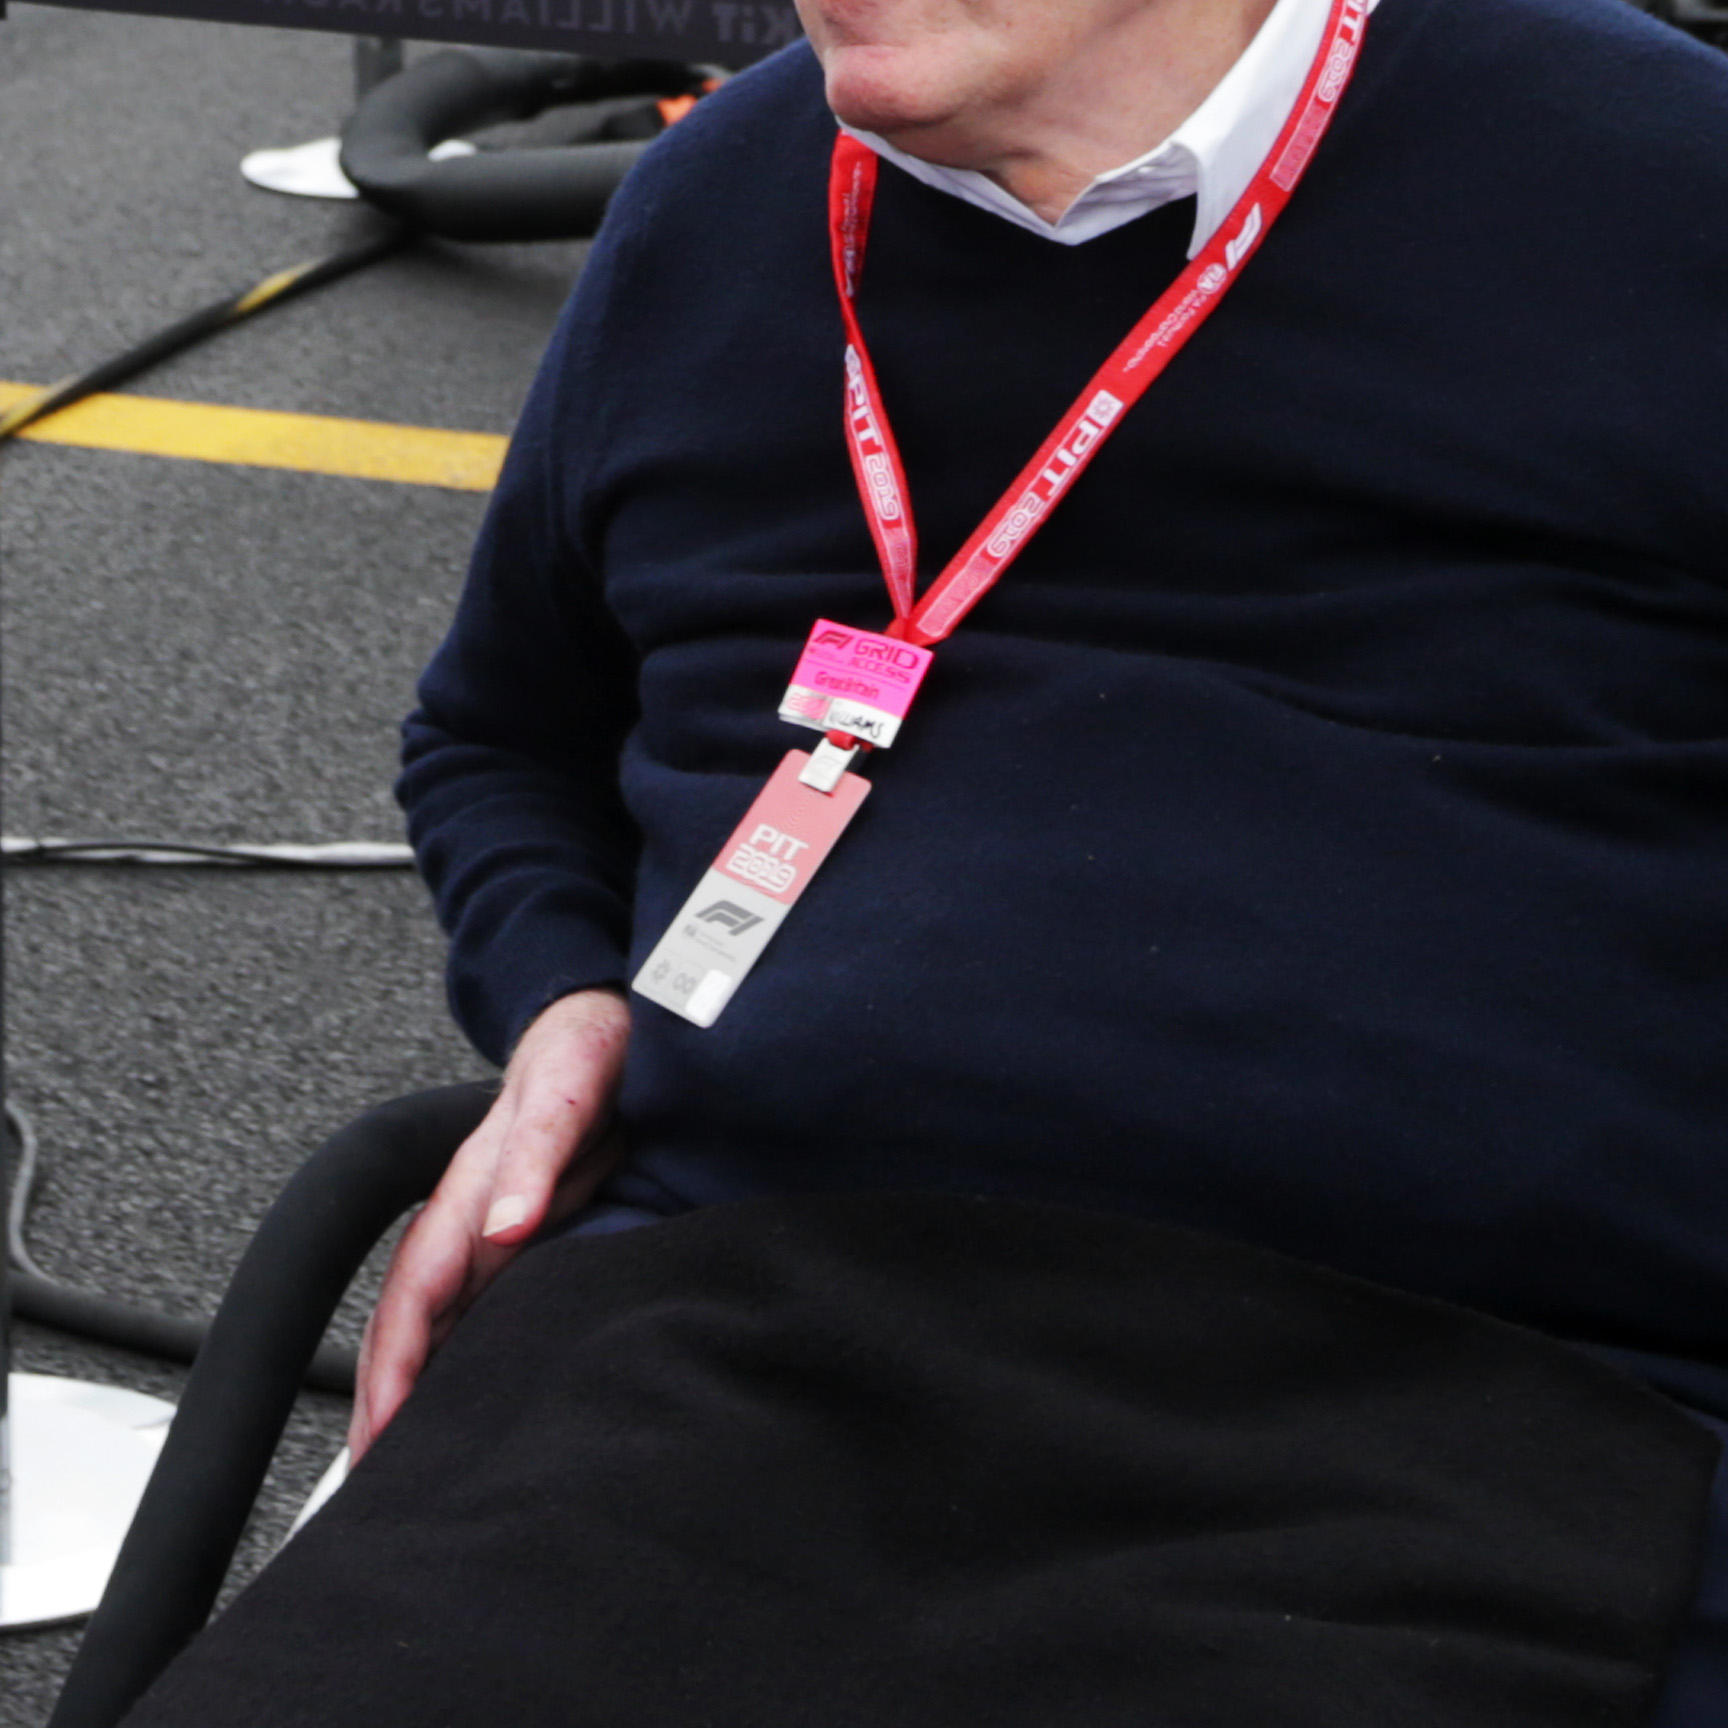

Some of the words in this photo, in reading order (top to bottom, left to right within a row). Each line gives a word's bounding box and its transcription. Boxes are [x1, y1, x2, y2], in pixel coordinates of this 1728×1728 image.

[1042, 419, 1101, 497] PIT
[849, 656, 914, 684] ACCESS
[854, 638, 920, 671] GRID
[748, 823, 811, 862] PIT
